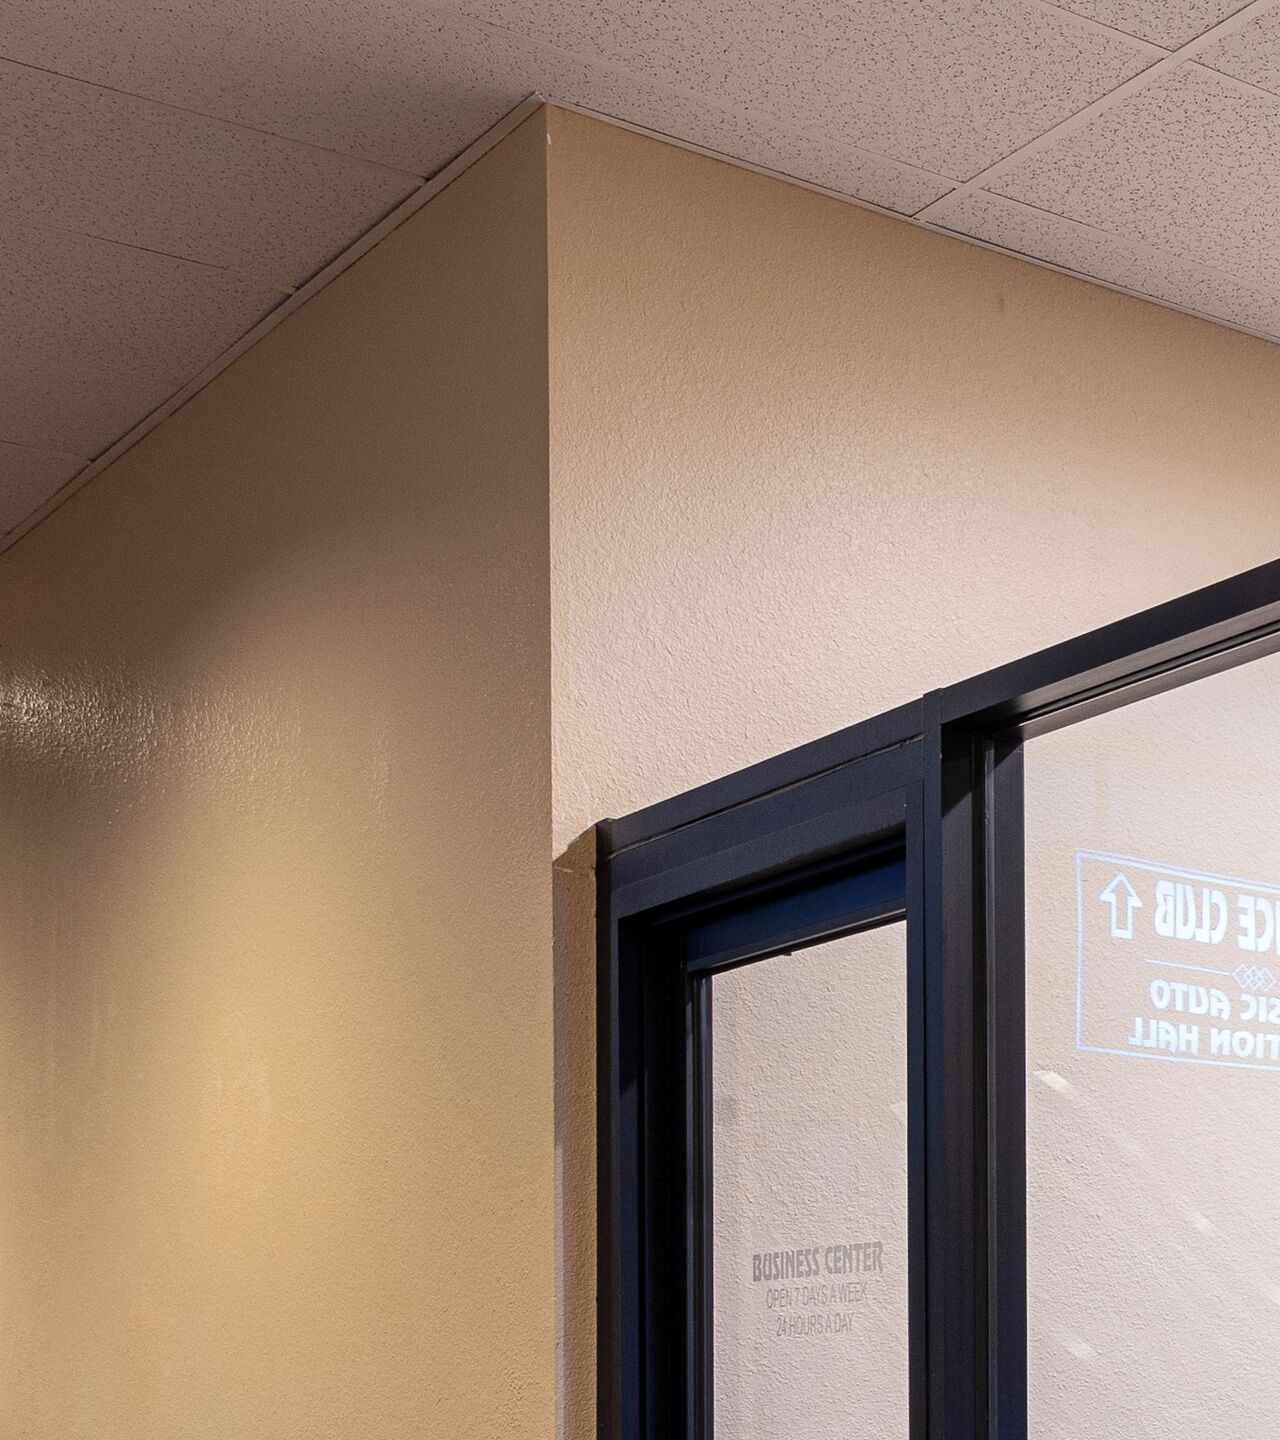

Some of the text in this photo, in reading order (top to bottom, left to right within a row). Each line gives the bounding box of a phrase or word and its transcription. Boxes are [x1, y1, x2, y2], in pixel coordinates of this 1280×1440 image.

[752, 1241, 883, 1282] BUSINESS CENTER
[766, 1287, 792, 1309] OPEN
[802, 1284, 828, 1306] DAYS
[838, 1281, 868, 1303] WEEK
[776, 1316, 787, 1337] 24
[788, 1314, 823, 1336] HOURS
[833, 1312, 854, 1333] DAY
